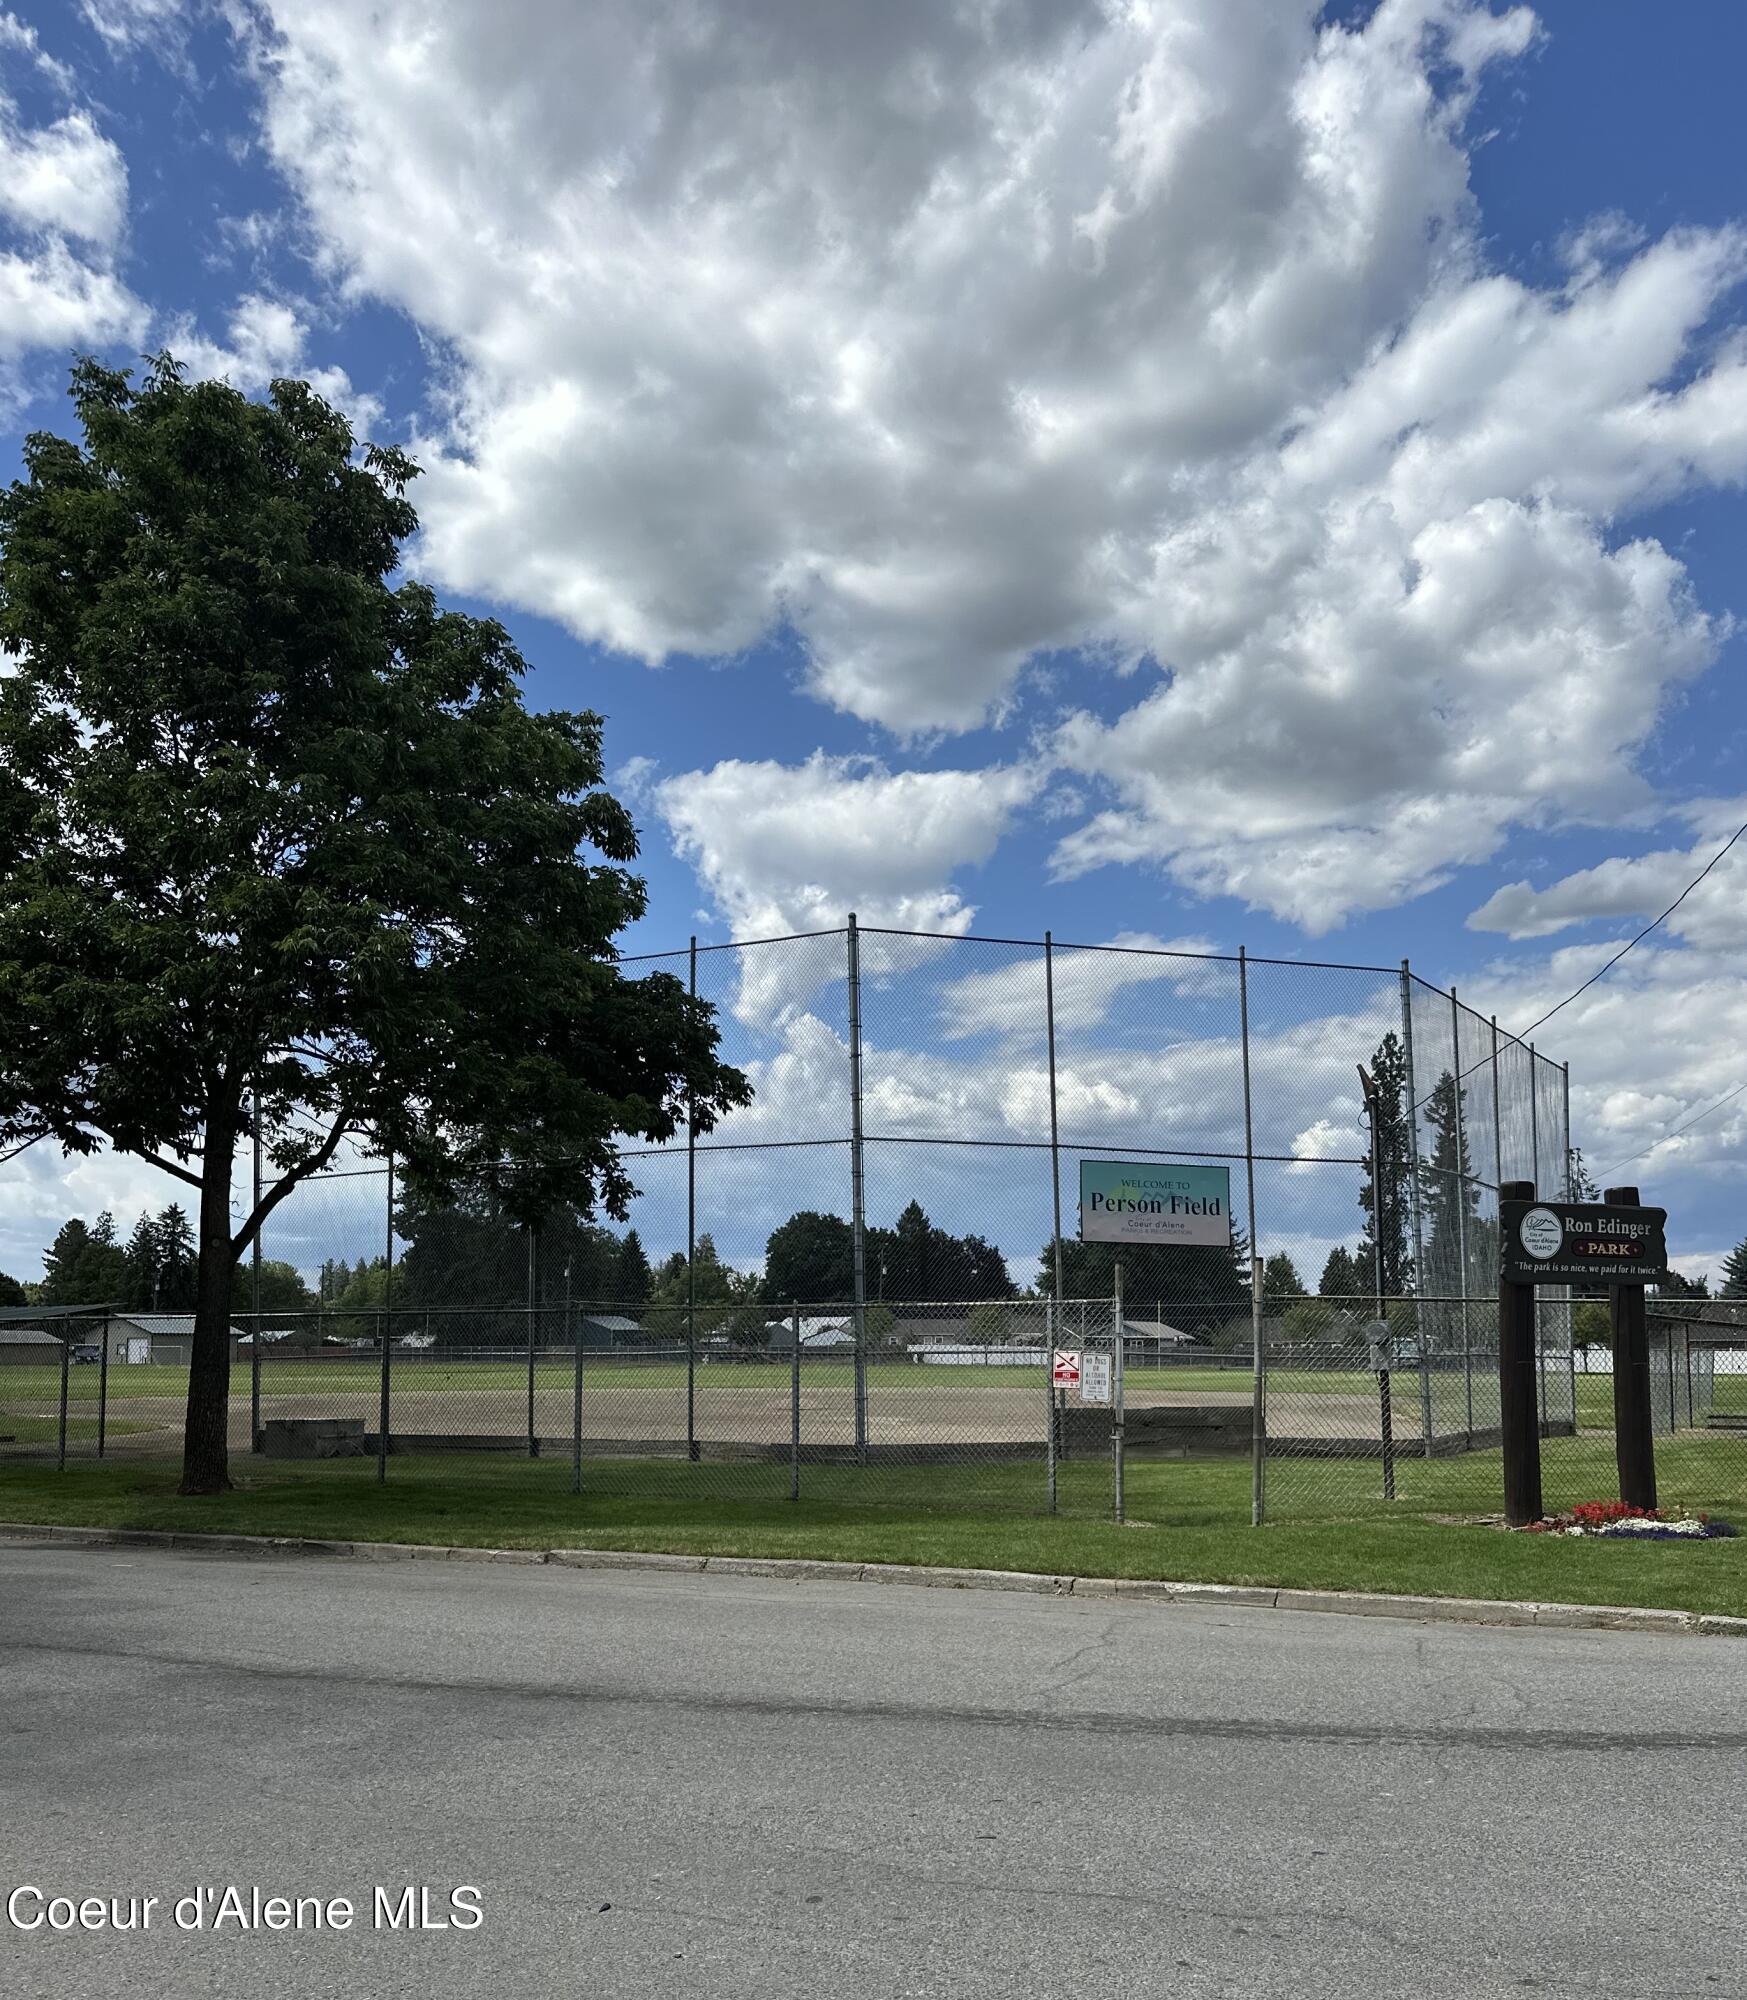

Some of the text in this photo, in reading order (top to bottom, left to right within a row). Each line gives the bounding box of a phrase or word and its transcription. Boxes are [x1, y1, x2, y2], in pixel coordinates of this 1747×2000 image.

[1121, 1179, 1190, 1190] WELCOME TO
[1091, 1192, 1221, 1216] Person Field
[1127, 1219, 1185, 1229] Coeur d'Alene
[1565, 1217, 1652, 1240] Ron Edinger
[1588, 1242, 1630, 1256] PARK
[1515, 1261, 1533, 1271] "The
[1534, 1262, 1551, 1273] park
[1552, 1263, 1559, 1271] is
[1560, 1264, 1569, 1272] so
[1588, 1265, 1599, 1273] we
[1600, 1264, 1617, 1275] paid
[1618, 1264, 1628, 1274] for
[1630, 1265, 1636, 1274] it
